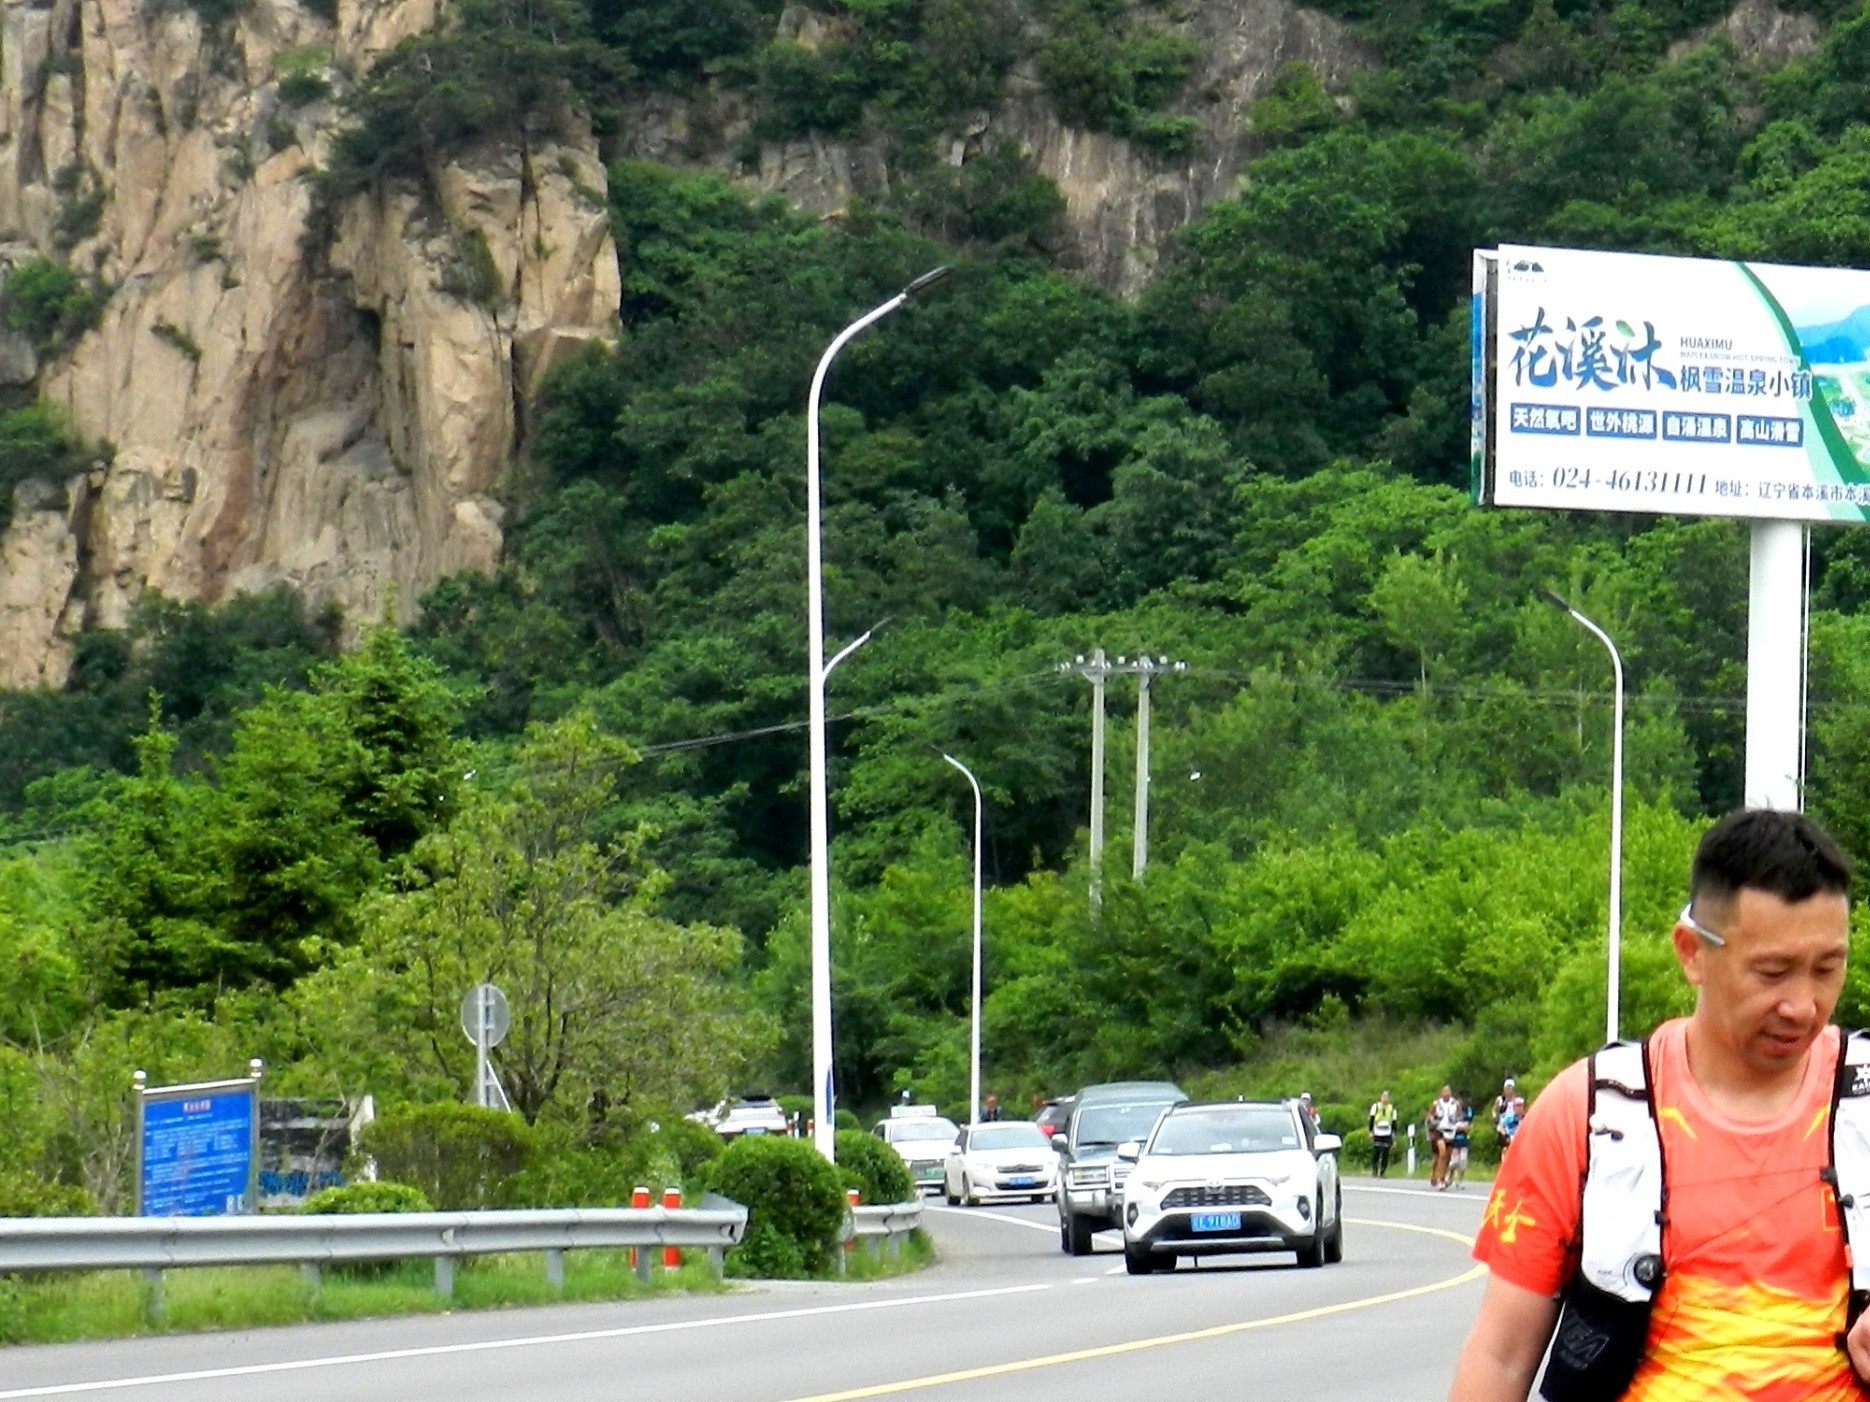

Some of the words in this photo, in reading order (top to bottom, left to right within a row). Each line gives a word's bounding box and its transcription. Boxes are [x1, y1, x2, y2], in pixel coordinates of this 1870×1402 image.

[1507, 306, 1678, 392] 花溪沐
[1680, 337, 1733, 351] HUAXIMU
[1680, 365, 1811, 399] 枫雪温泉小镇
[1513, 407, 1577, 431] 天然氧吧
[1589, 411, 1654, 435] 世外桃源
[1740, 418, 1800, 443] 高山滑雪
[1509, 469, 1544, 487] 电话：
[1552, 466, 1706, 494] 024-46131111
[1715, 480, 1749, 497] 地址：
